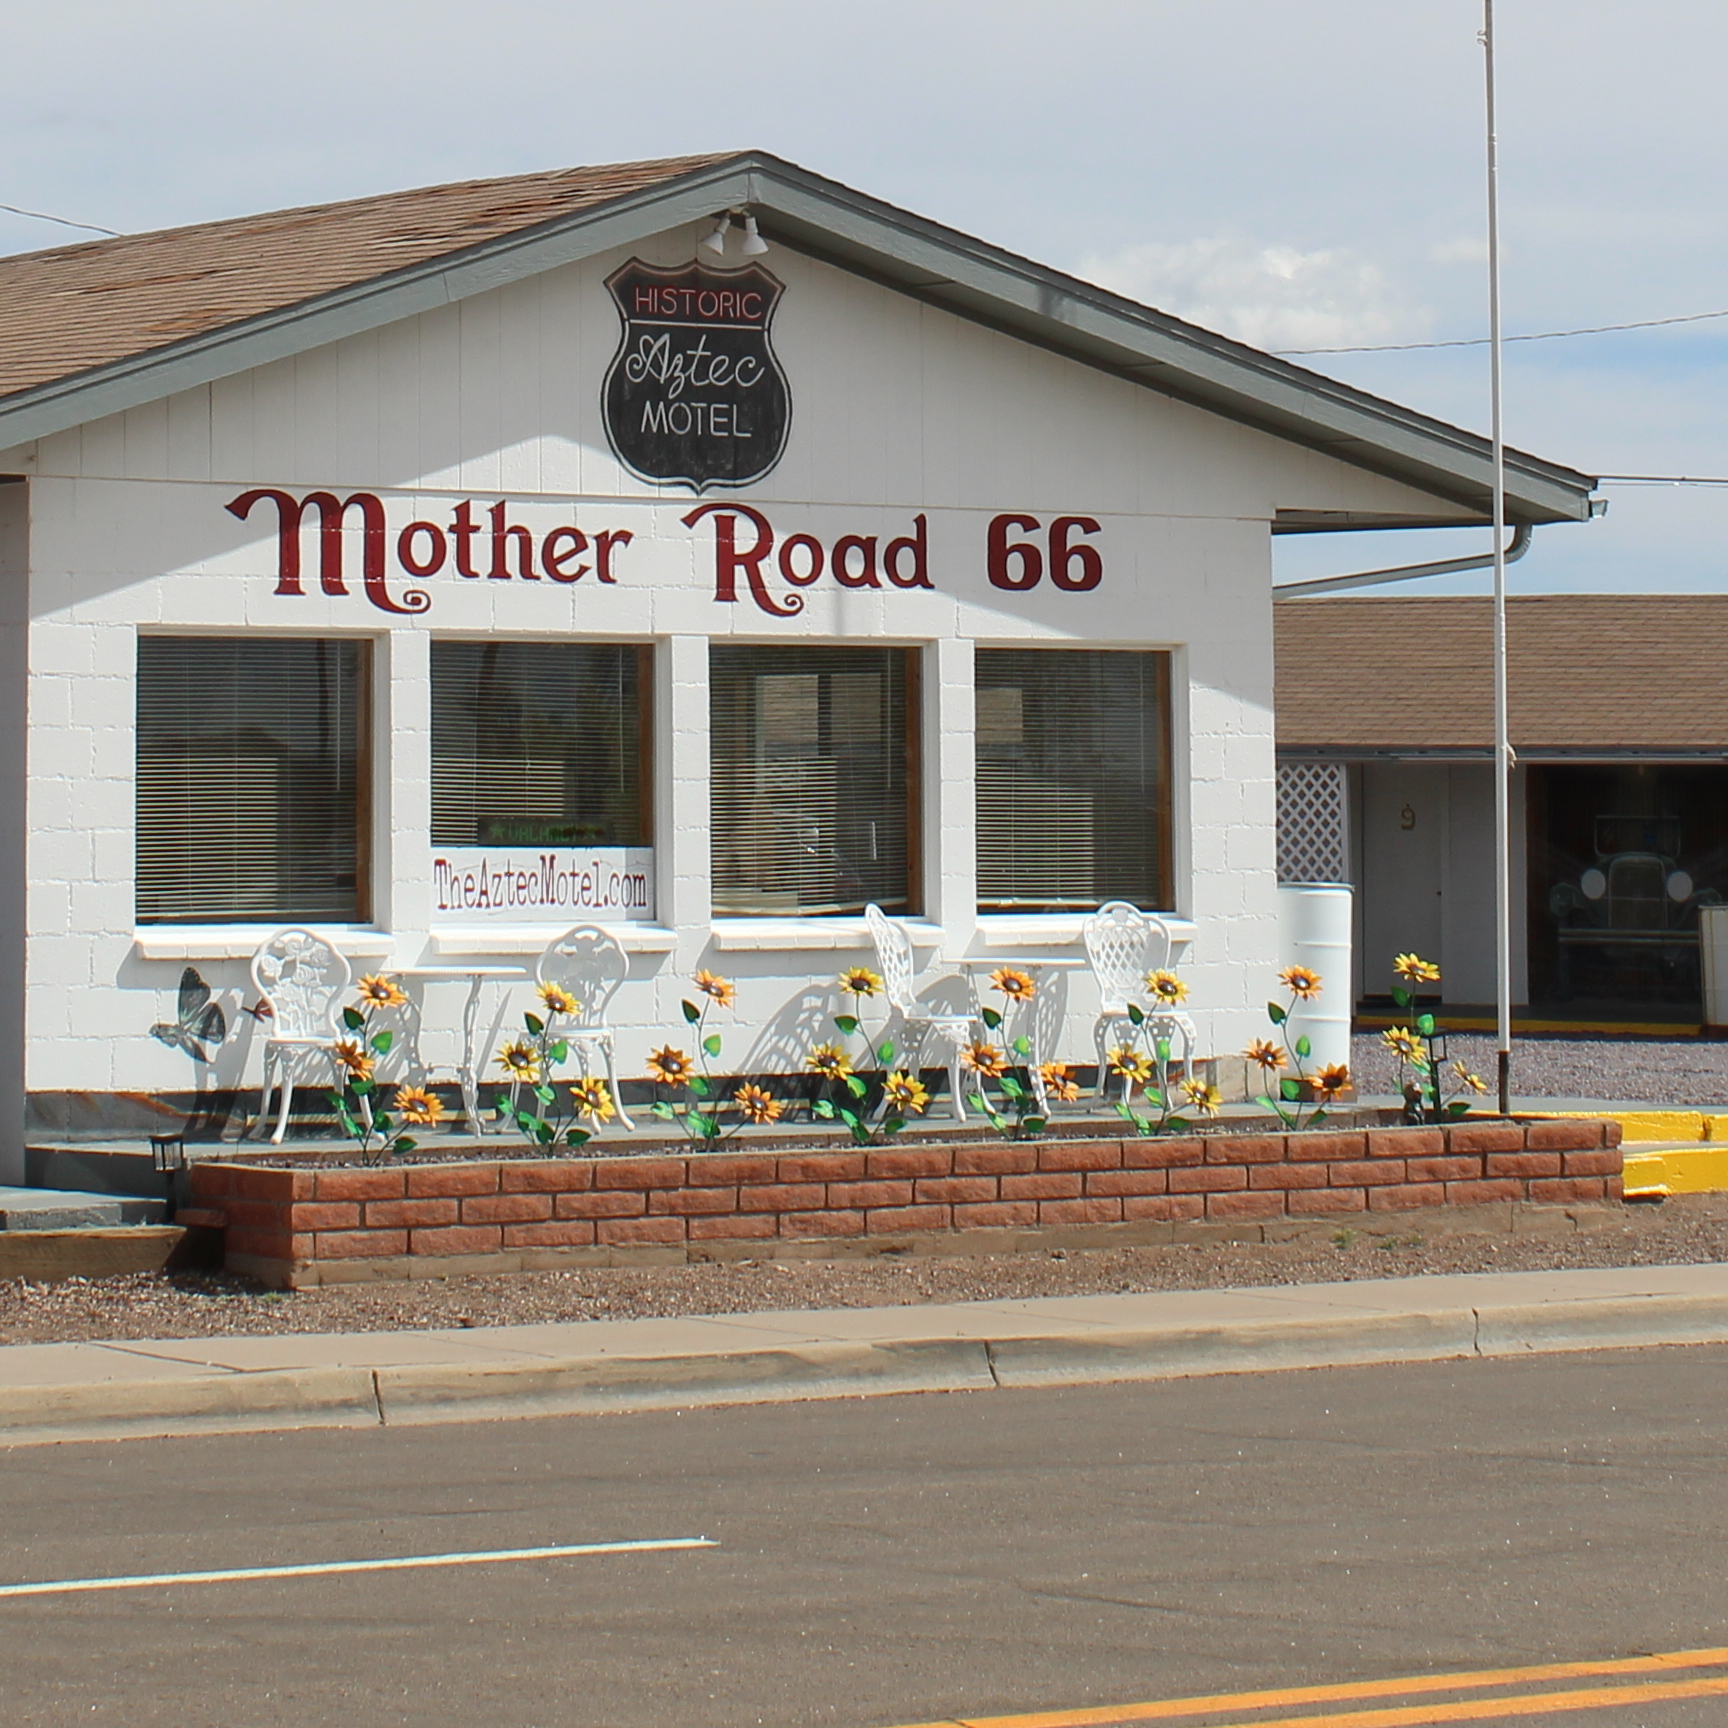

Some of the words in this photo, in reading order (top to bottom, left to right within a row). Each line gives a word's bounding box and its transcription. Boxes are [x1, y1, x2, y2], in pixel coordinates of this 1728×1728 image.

[634, 286, 763, 319] HISTORIC
[625, 332, 766, 400] Aztec
[640, 399, 753, 438] MOTEL
[224, 489, 634, 614] Mother
[680, 502, 936, 618] Road
[986, 513, 1103, 592] 66
[1401, 807, 1416, 830] 9
[433, 853, 647, 911] TheAztecMotel.com
